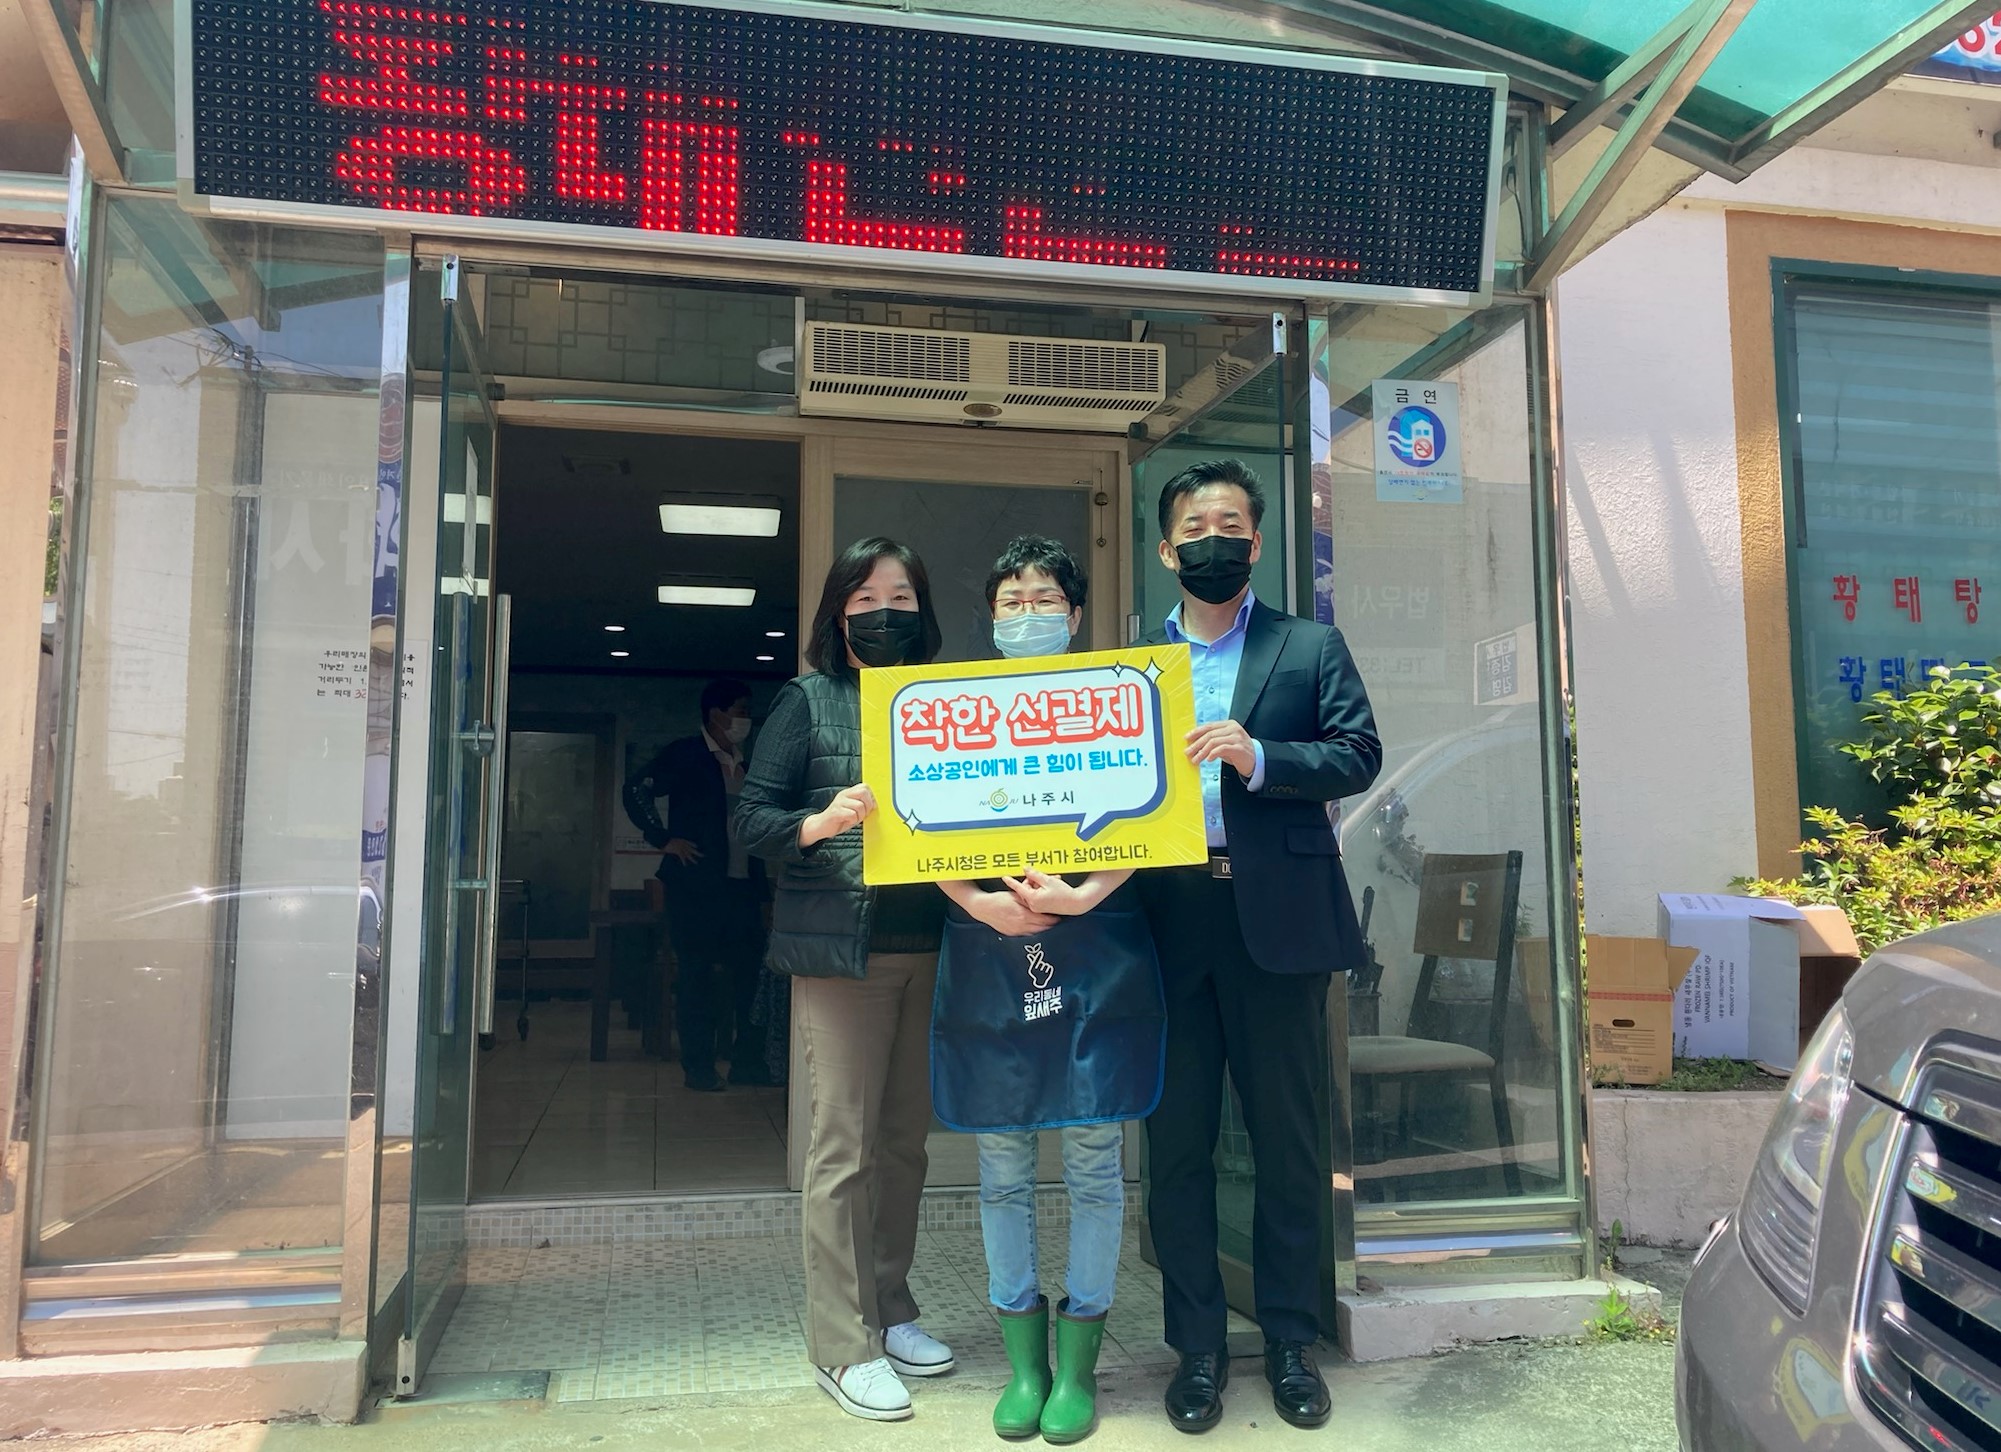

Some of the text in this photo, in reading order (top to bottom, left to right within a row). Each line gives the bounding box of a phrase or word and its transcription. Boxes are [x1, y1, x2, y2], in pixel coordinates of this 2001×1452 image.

[1839, 656, 1988, 703] 황태
[901, 683, 1145, 751] 착한 선결제
[908, 748, 1148, 782] 소상공인에게 큰 힘이 됩니다.
[917, 844, 1153, 873] 나주시청은 모든 부서가 참여합니다.
